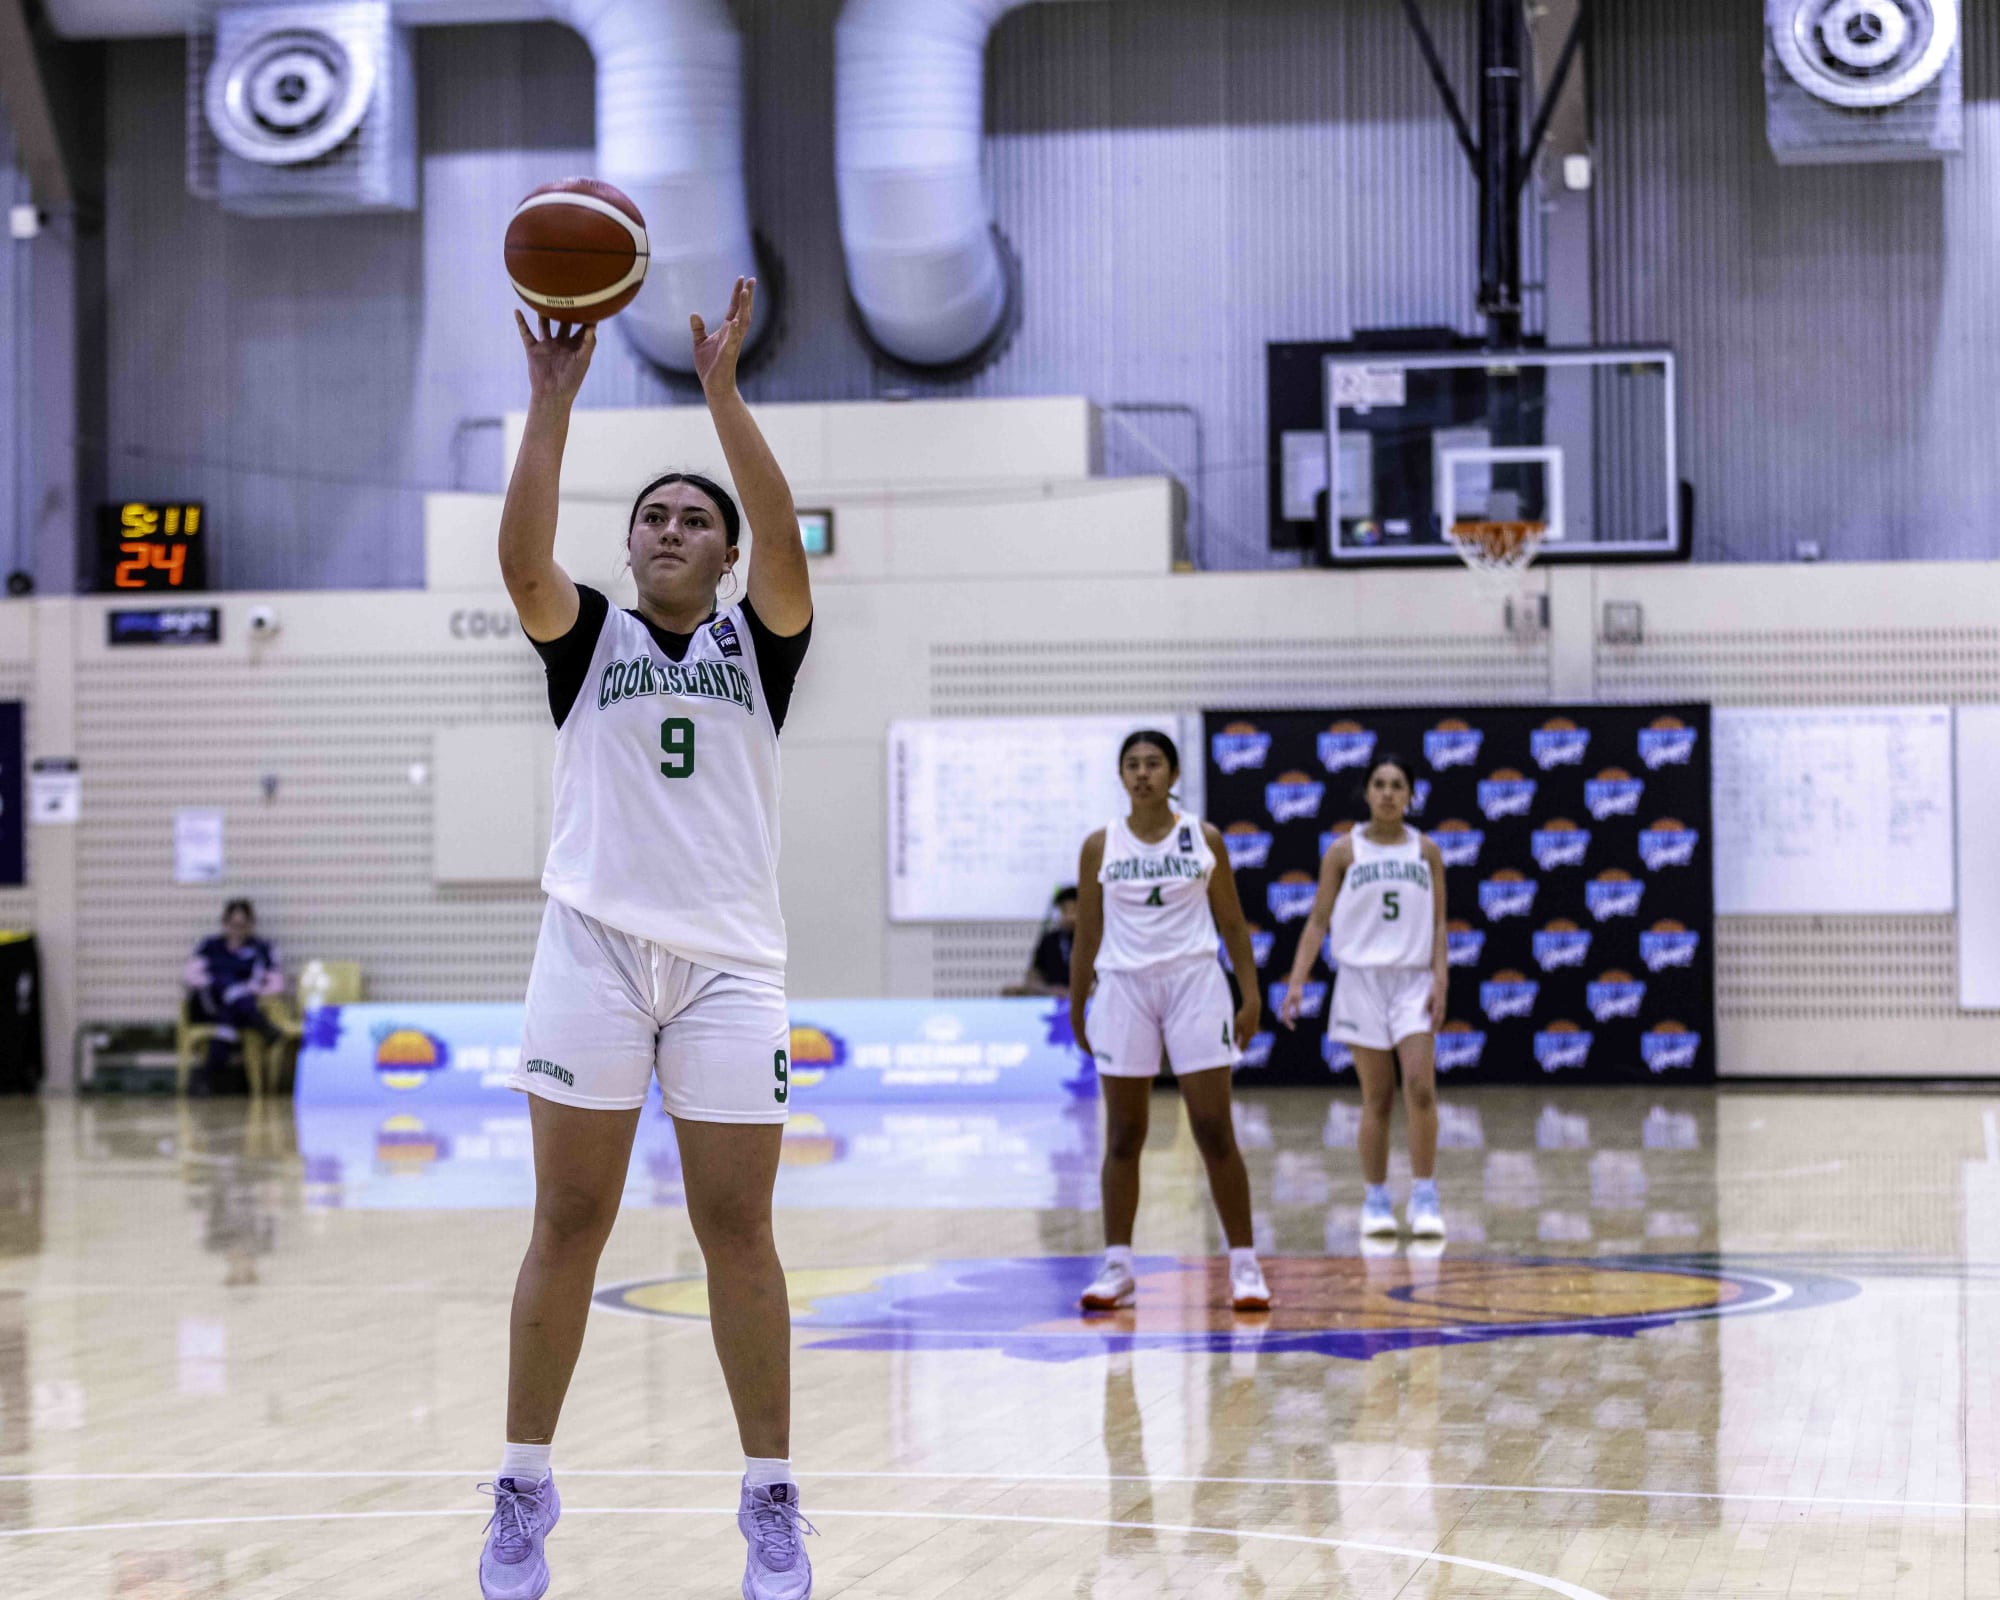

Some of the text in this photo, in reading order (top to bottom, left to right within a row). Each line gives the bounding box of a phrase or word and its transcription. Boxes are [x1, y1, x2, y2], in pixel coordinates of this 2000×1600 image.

[115, 542, 187, 588] 24
[449, 609, 520, 639] COU
[598, 655, 754, 715] COOK ISLANDS
[661, 718, 695, 778] 9
[1382, 891, 1399, 921] 5
[526, 1060, 574, 1087] COOK ISLANDS
[774, 1049, 787, 1103] 9
